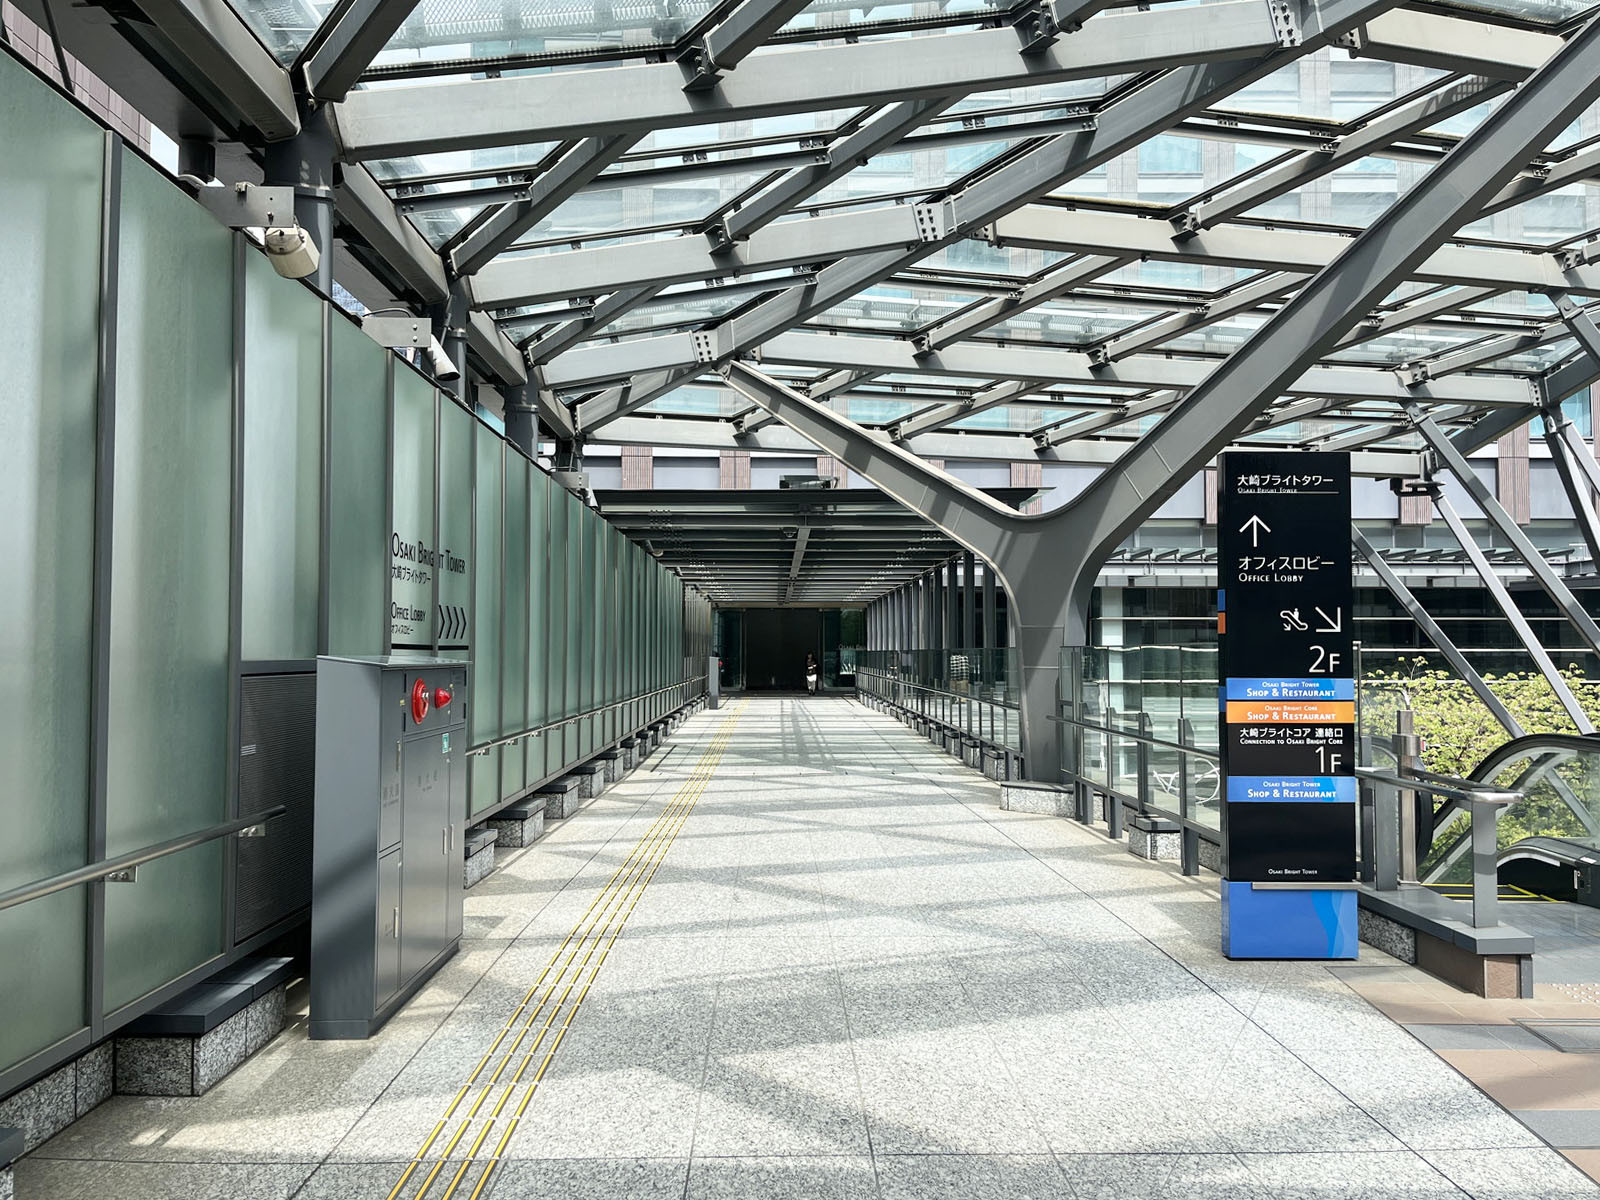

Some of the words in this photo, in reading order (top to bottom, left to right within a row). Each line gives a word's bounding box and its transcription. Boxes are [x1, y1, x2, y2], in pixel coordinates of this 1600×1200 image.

[1237, 474, 1334, 486] 大崎ブライトタワー
[392, 532, 416, 561] OSAKI
[418, 541, 444, 569] BRIGT
[445, 549, 465, 574] TOWER
[1238, 555, 1335, 570] オフィスロビー
[1238, 572, 1270, 582] OFFICE
[1274, 572, 1304, 582] LOBBY
[391, 601, 409, 620] OFFICE
[410, 604, 426, 622] LOBBY
[1308, 645, 1341, 673] 2F
[1246, 687, 1269, 697] SHOP
[1271, 687, 1279, 697] &
[1282, 687, 1336, 697] RESTAURANT
[1247, 711, 1269, 721] SHOP
[1271, 711, 1279, 721] &
[1282, 711, 1336, 721] RESTAURANT
[1239, 728, 1311, 738] 大崎ブライトコア
[1315, 728, 1343, 738] 連絡口
[1315, 746, 1342, 774] 1F
[1247, 789, 1270, 798] SHOP
[1272, 788, 1280, 798] &
[1283, 788, 1336, 798] RESTAURANT
